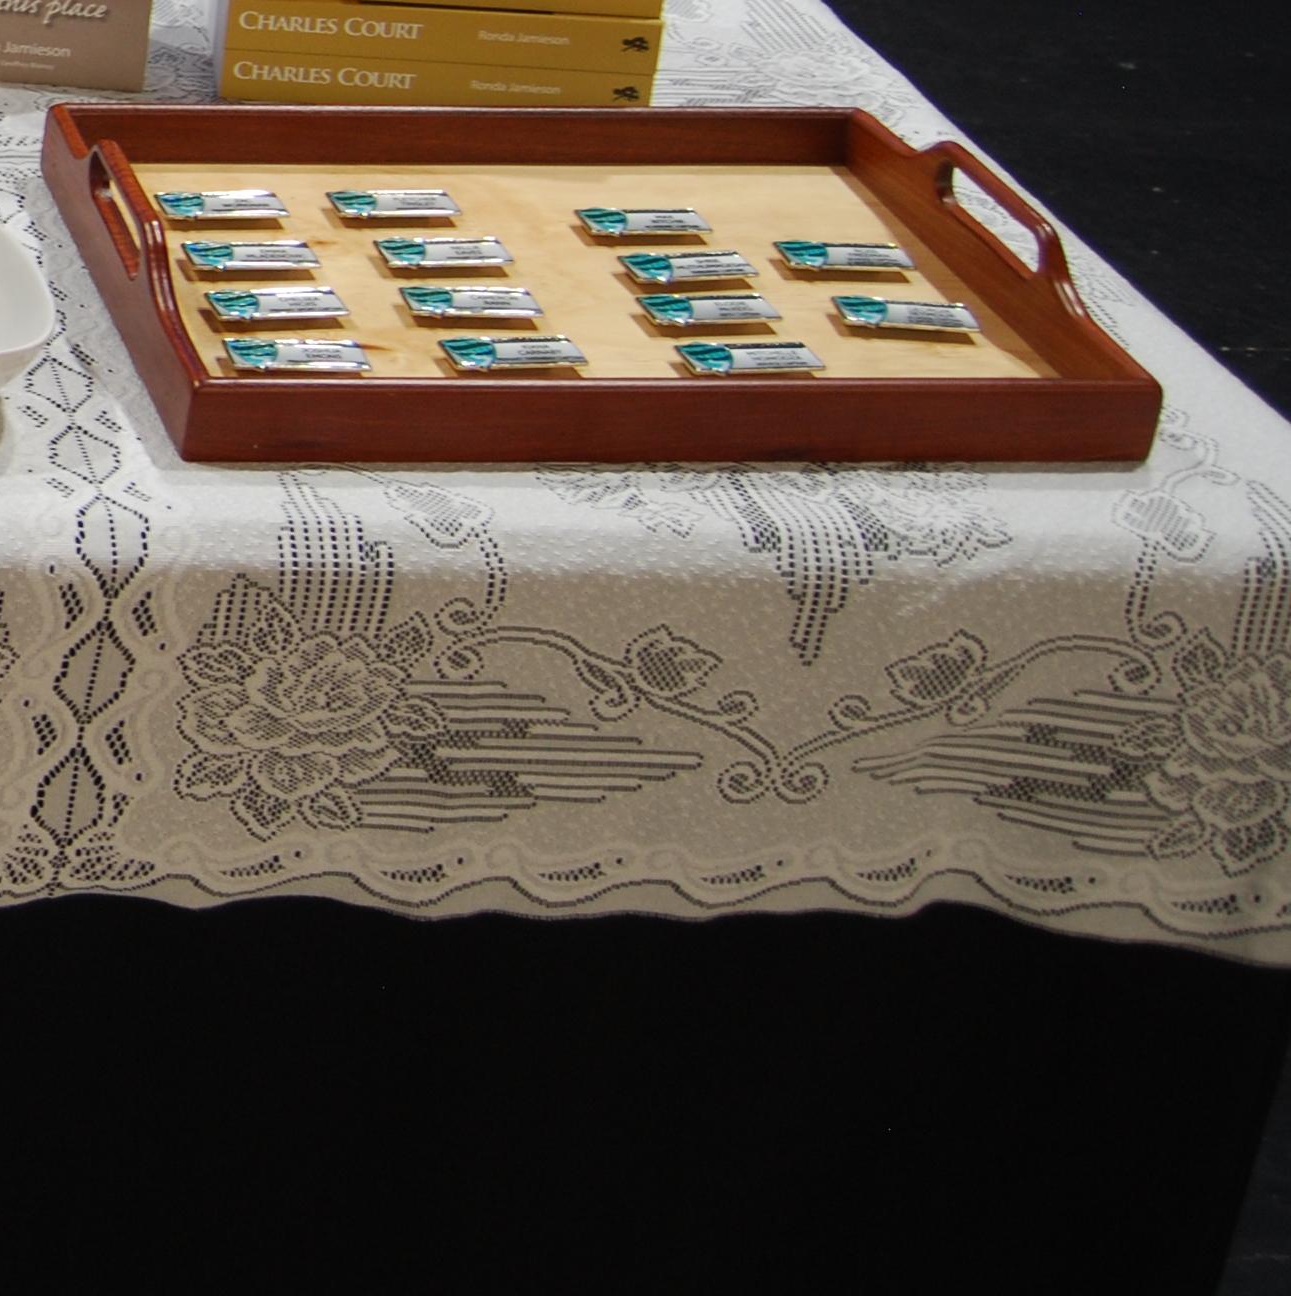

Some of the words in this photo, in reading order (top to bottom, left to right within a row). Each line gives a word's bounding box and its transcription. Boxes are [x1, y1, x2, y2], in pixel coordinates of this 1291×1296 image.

[239, 10, 338, 34] CHARLES
[344, 17, 424, 39] COURT
[3, 41, 71, 57] Jamieson
[233, 61, 331, 85] CHARLES
[337, 67, 417, 89] COURT
